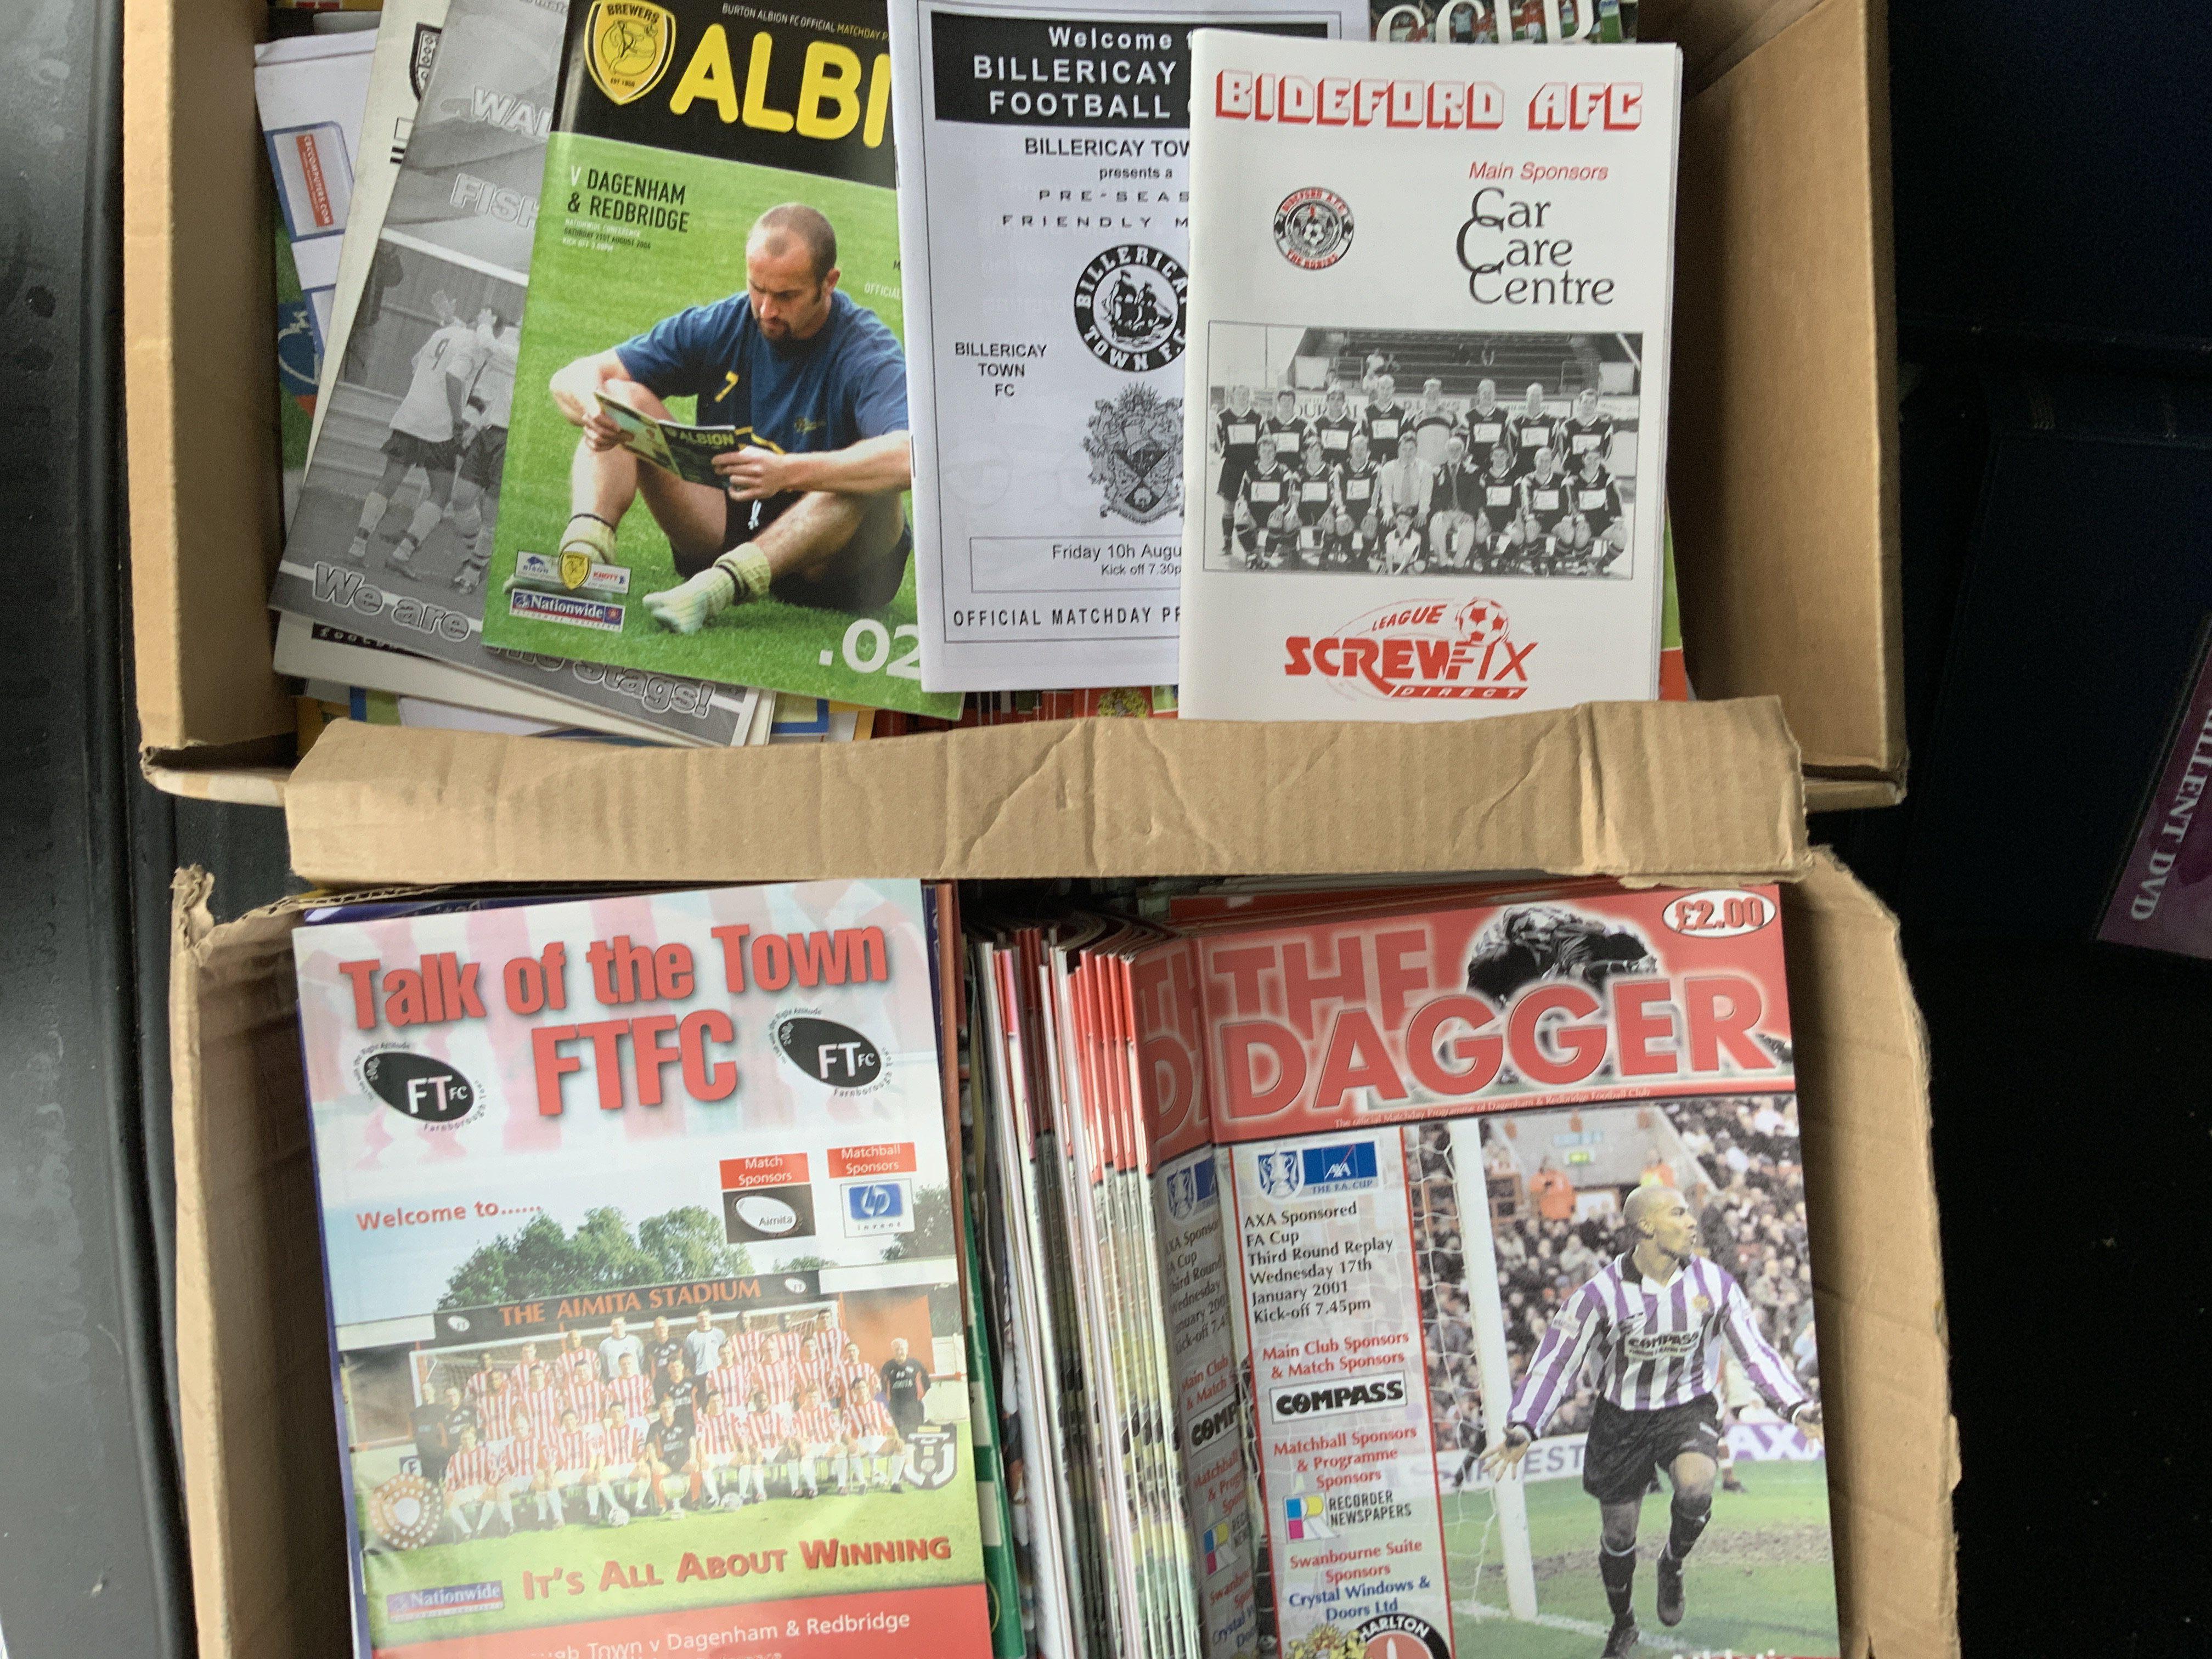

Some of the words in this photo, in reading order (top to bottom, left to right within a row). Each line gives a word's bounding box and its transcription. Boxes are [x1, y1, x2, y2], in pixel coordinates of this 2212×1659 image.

[607, 3, 660, 23] BREWERS
[722, 3, 755, 18] BURTON
[757, 11, 788, 24] ALBION
[789, 15, 799, 26] FC
[800, 16, 835, 32] OFFICIAL
[837, 22, 880, 41] MATCHDAY
[1048, 26, 1172, 51] Welcome
[973, 55, 1177, 85] BILLERICAY
[989, 91, 1171, 120] FOOTBALL
[1216, 69, 1506, 129] BIDEFORD
[1528, 81, 1644, 131] AFC
[1025, 138, 1145, 156] BILLERICAY
[1099, 167, 1160, 180] presents
[1165, 168, 1173, 179] a
[1469, 162, 1513, 179] Main
[1520, 162, 1609, 184] Sponsors
[587, 168, 686, 206] DAGENHAM
[1039, 190, 1189, 202] PRE-SEAS
[568, 190, 580, 213] &
[589, 195, 690, 233] REDBRIDGE
[1470, 187, 1551, 230] Car
[1002, 215, 1151, 228] FRIENDLY
[564, 227, 593, 239] SATURDAY
[612, 236, 634, 247] AUGUST
[1455, 215, 1573, 274] Care
[1468, 263, 1615, 306] Centre
[955, 341, 1047, 357] BILLERICAY
[1084, 325, 1148, 371] TOWN
[978, 363, 1025, 377] TOWN
[995, 383, 1015, 397] FC
[680, 430, 735, 445] ALBION
[1052, 544, 1101, 562] Friday
[1107, 545, 1135, 558] 10h
[1101, 565, 1126, 576] Kick
[1130, 564, 1144, 575] off
[312, 561, 383, 616] We
[391, 597, 471, 642] are
[531, 595, 603, 619] Nationwide
[953, 609, 1041, 628] OFFICIAL
[1052, 607, 1152, 625] MATCHDAY
[1371, 604, 1447, 631] LEAGUE
[1284, 635, 1538, 689] SCREWFIX
[1401, 687, 1521, 699] DIRECT
[2130, 849, 2176, 921] DVD
[1674, 896, 1765, 932] £2.00
[338, 952, 487, 1030] Talk
[503, 940, 567, 1015] of
[585, 934, 695, 1006] the
[710, 924, 888, 994] Town
[1219, 975, 1777, 1120] DAGGER
[530, 1009, 740, 1118] FTFC
[744, 1156, 783, 1170] Match
[841, 1144, 901, 1159] Matchball
[738, 1171, 793, 1187] Sponsors
[845, 1162, 899, 1176] Sponsors
[1325, 1161, 1352, 1180] AXA
[1311, 1185, 1331, 1194] THE
[1352, 1180, 1373, 1189] CUP
[865, 1185, 887, 1216] hp
[357, 1206, 466, 1232] Welcome
[857, 1222, 901, 1231] invent
[1244, 1214, 1276, 1229] AXA
[1281, 1201, 1357, 1226] Sponsored
[1246, 1233, 1265, 1248] FA
[1269, 1231, 1299, 1246] Cup
[1249, 1250, 1286, 1267] Third
[1293, 1241, 1339, 1260] Round
[1345, 1237, 1393, 1257] Replay
[1177, 1252, 1197, 1271] Cup
[1249, 1263, 1333, 1286] Wednesday
[1339, 1257, 1372, 1273] 17th
[499, 1302, 545, 1327] THE
[556, 1291, 642, 1319] AIMITA
[649, 1278, 762, 1309] STADIUM
[1251, 1287, 1307, 1307] January
[1313, 1279, 1347, 1297] 2001
[1254, 1303, 1310, 1324] Kick-off
[1316, 1297, 1371, 1316] 7.45pm
[1262, 1344, 1299, 1362] Main
[1305, 1336, 1339, 1355] Club
[1344, 1332, 1409, 1353] Sponsors
[1271, 1367, 1283, 1379] &
[1288, 1358, 1335, 1378] Match
[1339, 1352, 1404, 1373] Sponsors
[1276, 1380, 1403, 1415] COMPASS
[1273, 1432, 1347, 1456] Matchball
[1352, 1426, 1417, 1447] Sponsors
[1296, 1459, 1308, 1471] &
[1314, 1449, 1398, 1470] Programme
[1317, 1471, 1381, 1490] Sponsors
[1329, 1489, 1393, 1510] RECORDER
[1330, 1503, 1412, 1527] NEWSPAPERS
[1290, 1548, 1381, 1569] Swanbourne
[1386, 1539, 1423, 1556] Suite
[1325, 1564, 1391, 1585] Sponsors
[410, 1582, 501, 1607] Nationwide
[1289, 1587, 1340, 1610] Crystal
[1346, 1580, 1414, 1599] Windows
[1418, 1575, 1430, 1589] &
[1325, 1604, 1370, 1622] Doors
[1375, 1597, 1398, 1615] Ltd
[649, 1639, 661, 1652] v
[667, 1622, 778, 1651] Dagenham
[786, 1620, 800, 1637] &
[808, 1612, 911, 1638] Redbridge
